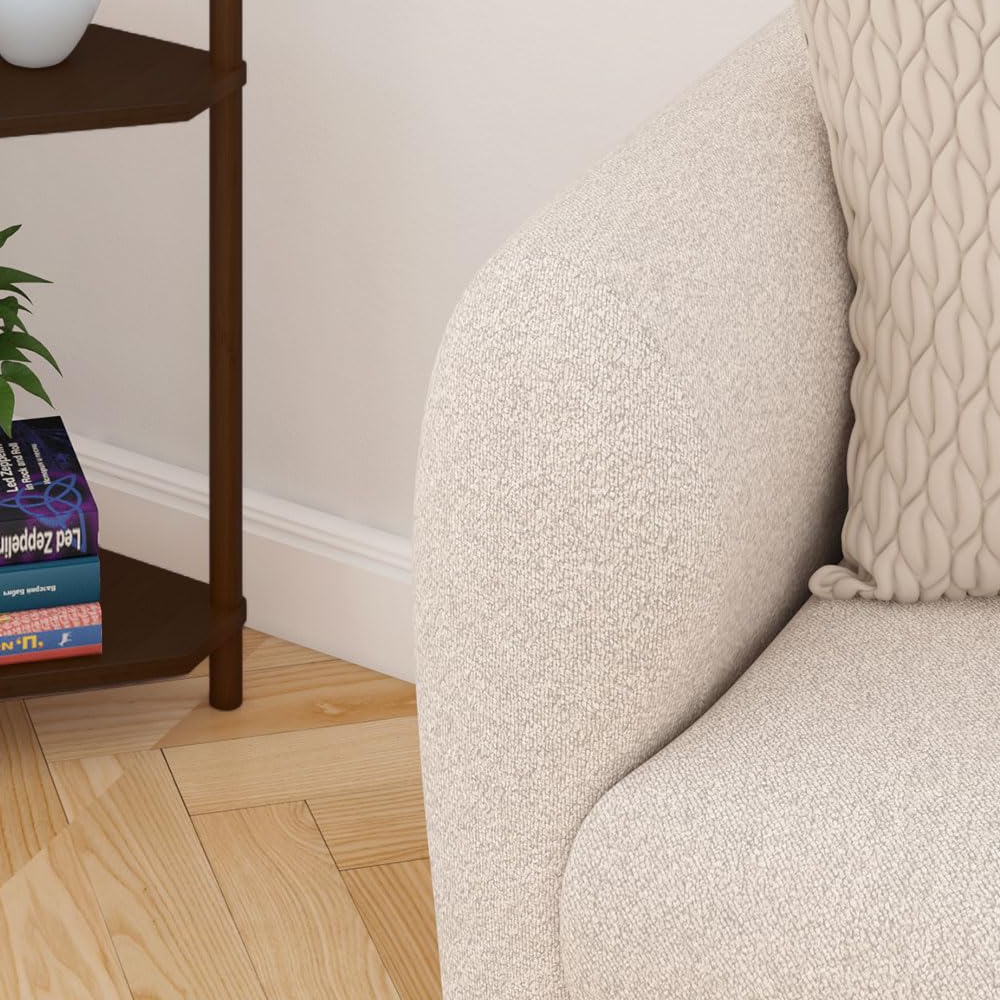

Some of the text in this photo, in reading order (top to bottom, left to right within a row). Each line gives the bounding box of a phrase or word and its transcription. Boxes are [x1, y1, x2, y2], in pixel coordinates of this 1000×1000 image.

[8, 442, 35, 491] in Rock and Roll
[2, 477, 19, 493] Led
[56, 528, 81, 552] Led
